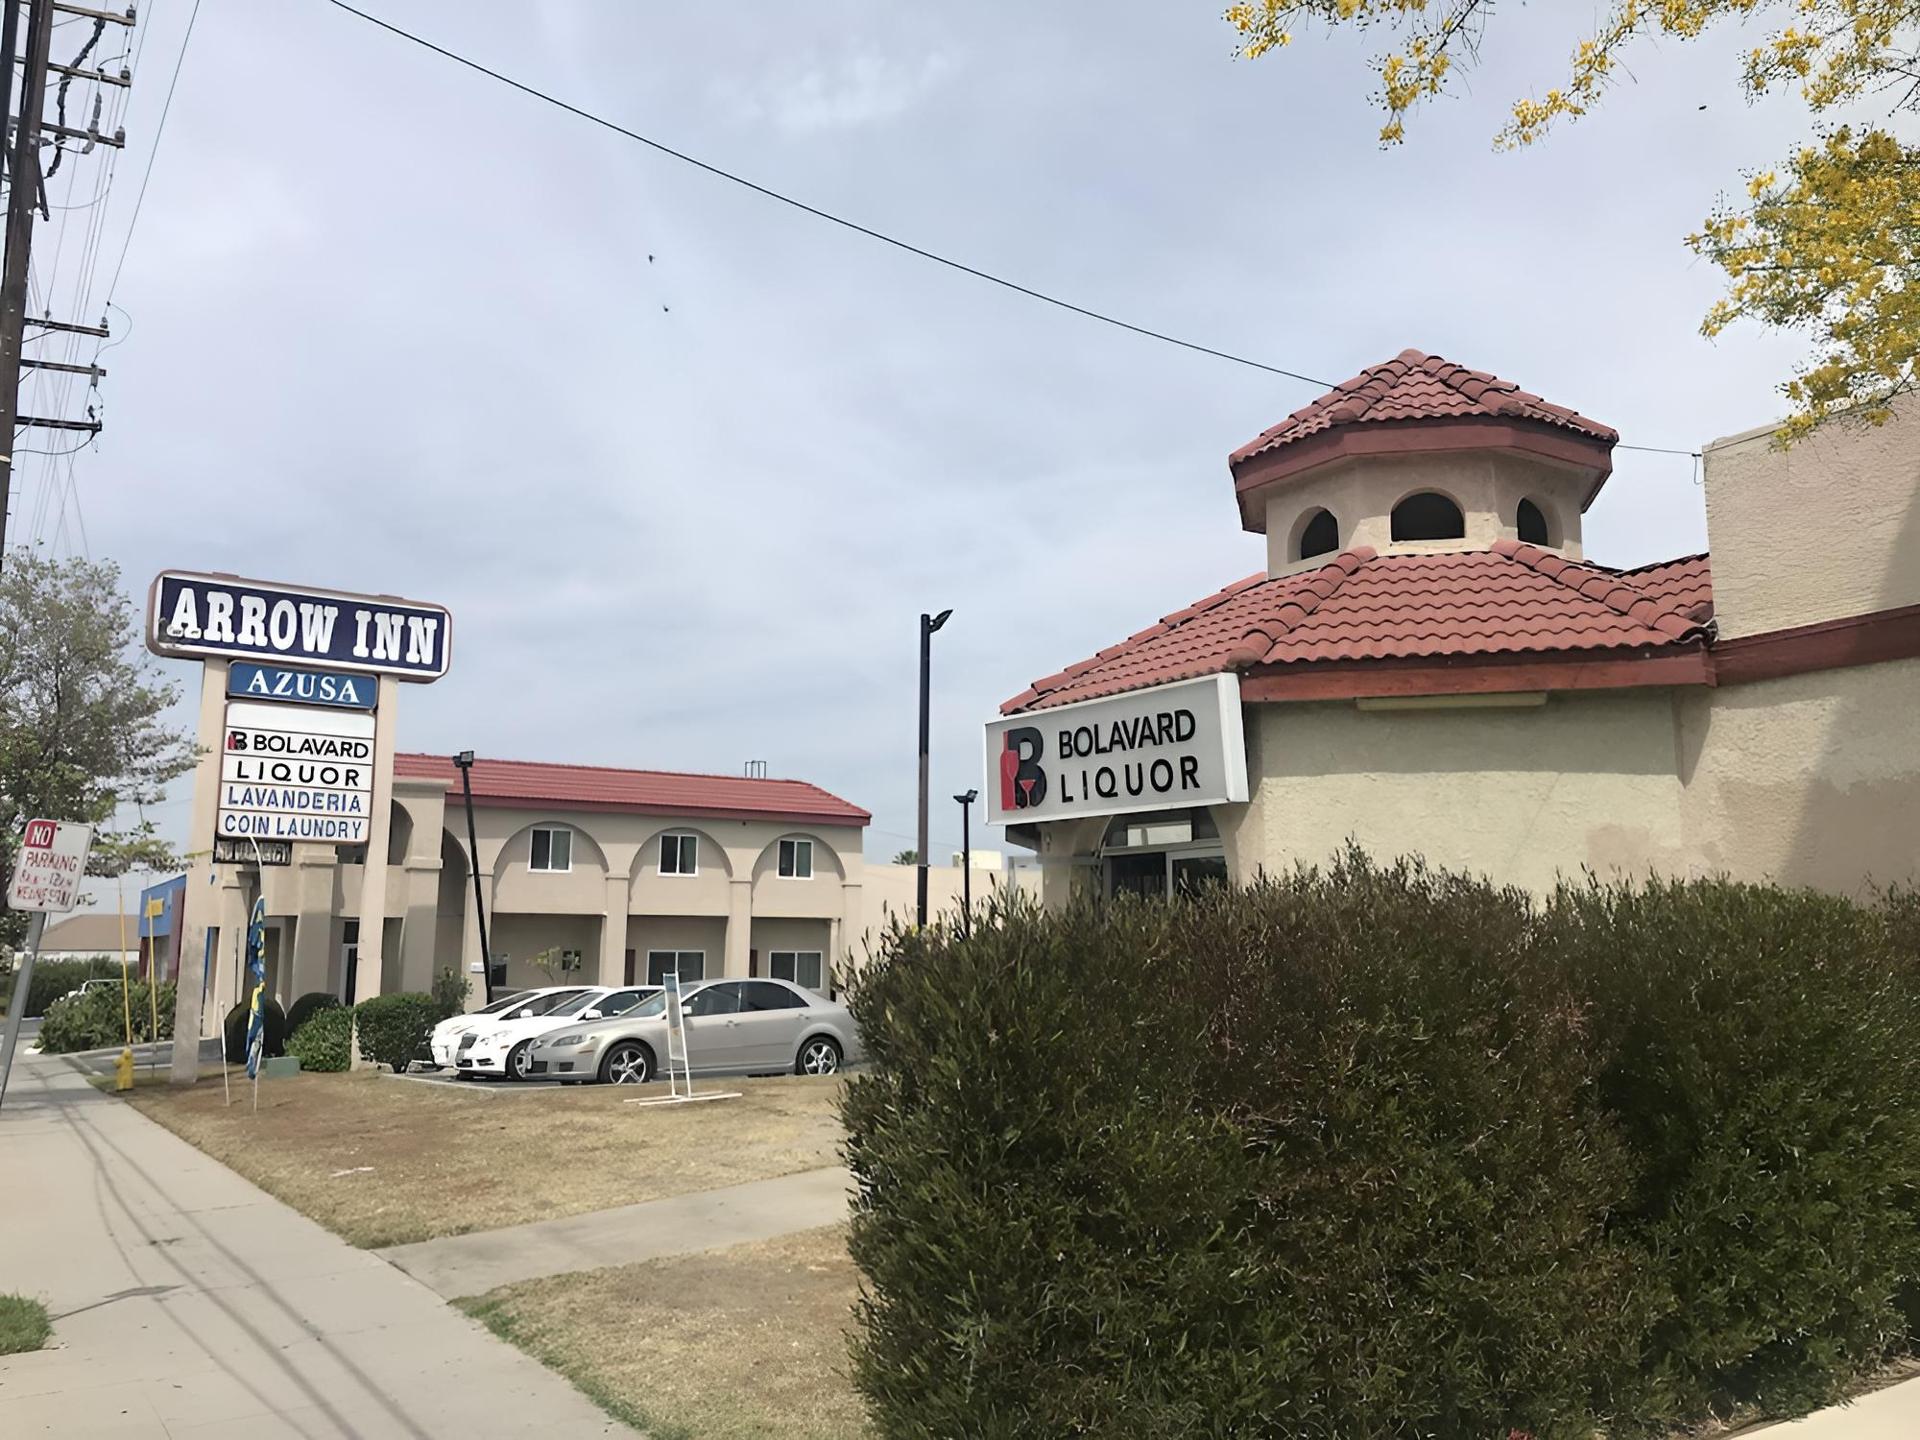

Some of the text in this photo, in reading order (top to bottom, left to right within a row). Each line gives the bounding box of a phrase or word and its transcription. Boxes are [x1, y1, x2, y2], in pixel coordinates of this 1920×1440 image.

[166, 587, 438, 665] ARROW INN
[247, 669, 360, 703] AZUSA
[253, 734, 369, 759] BOLAVARD
[1059, 709, 1196, 759] BOLAVARD
[236, 760, 360, 787] LIQUOR
[1060, 755, 1201, 803] LIQUOR
[227, 786, 362, 813] LAVANDERIA
[31, 825, 52, 846] NO
[224, 814, 362, 840] COIN LAUNDRY
[25, 851, 79, 872] PARKING
